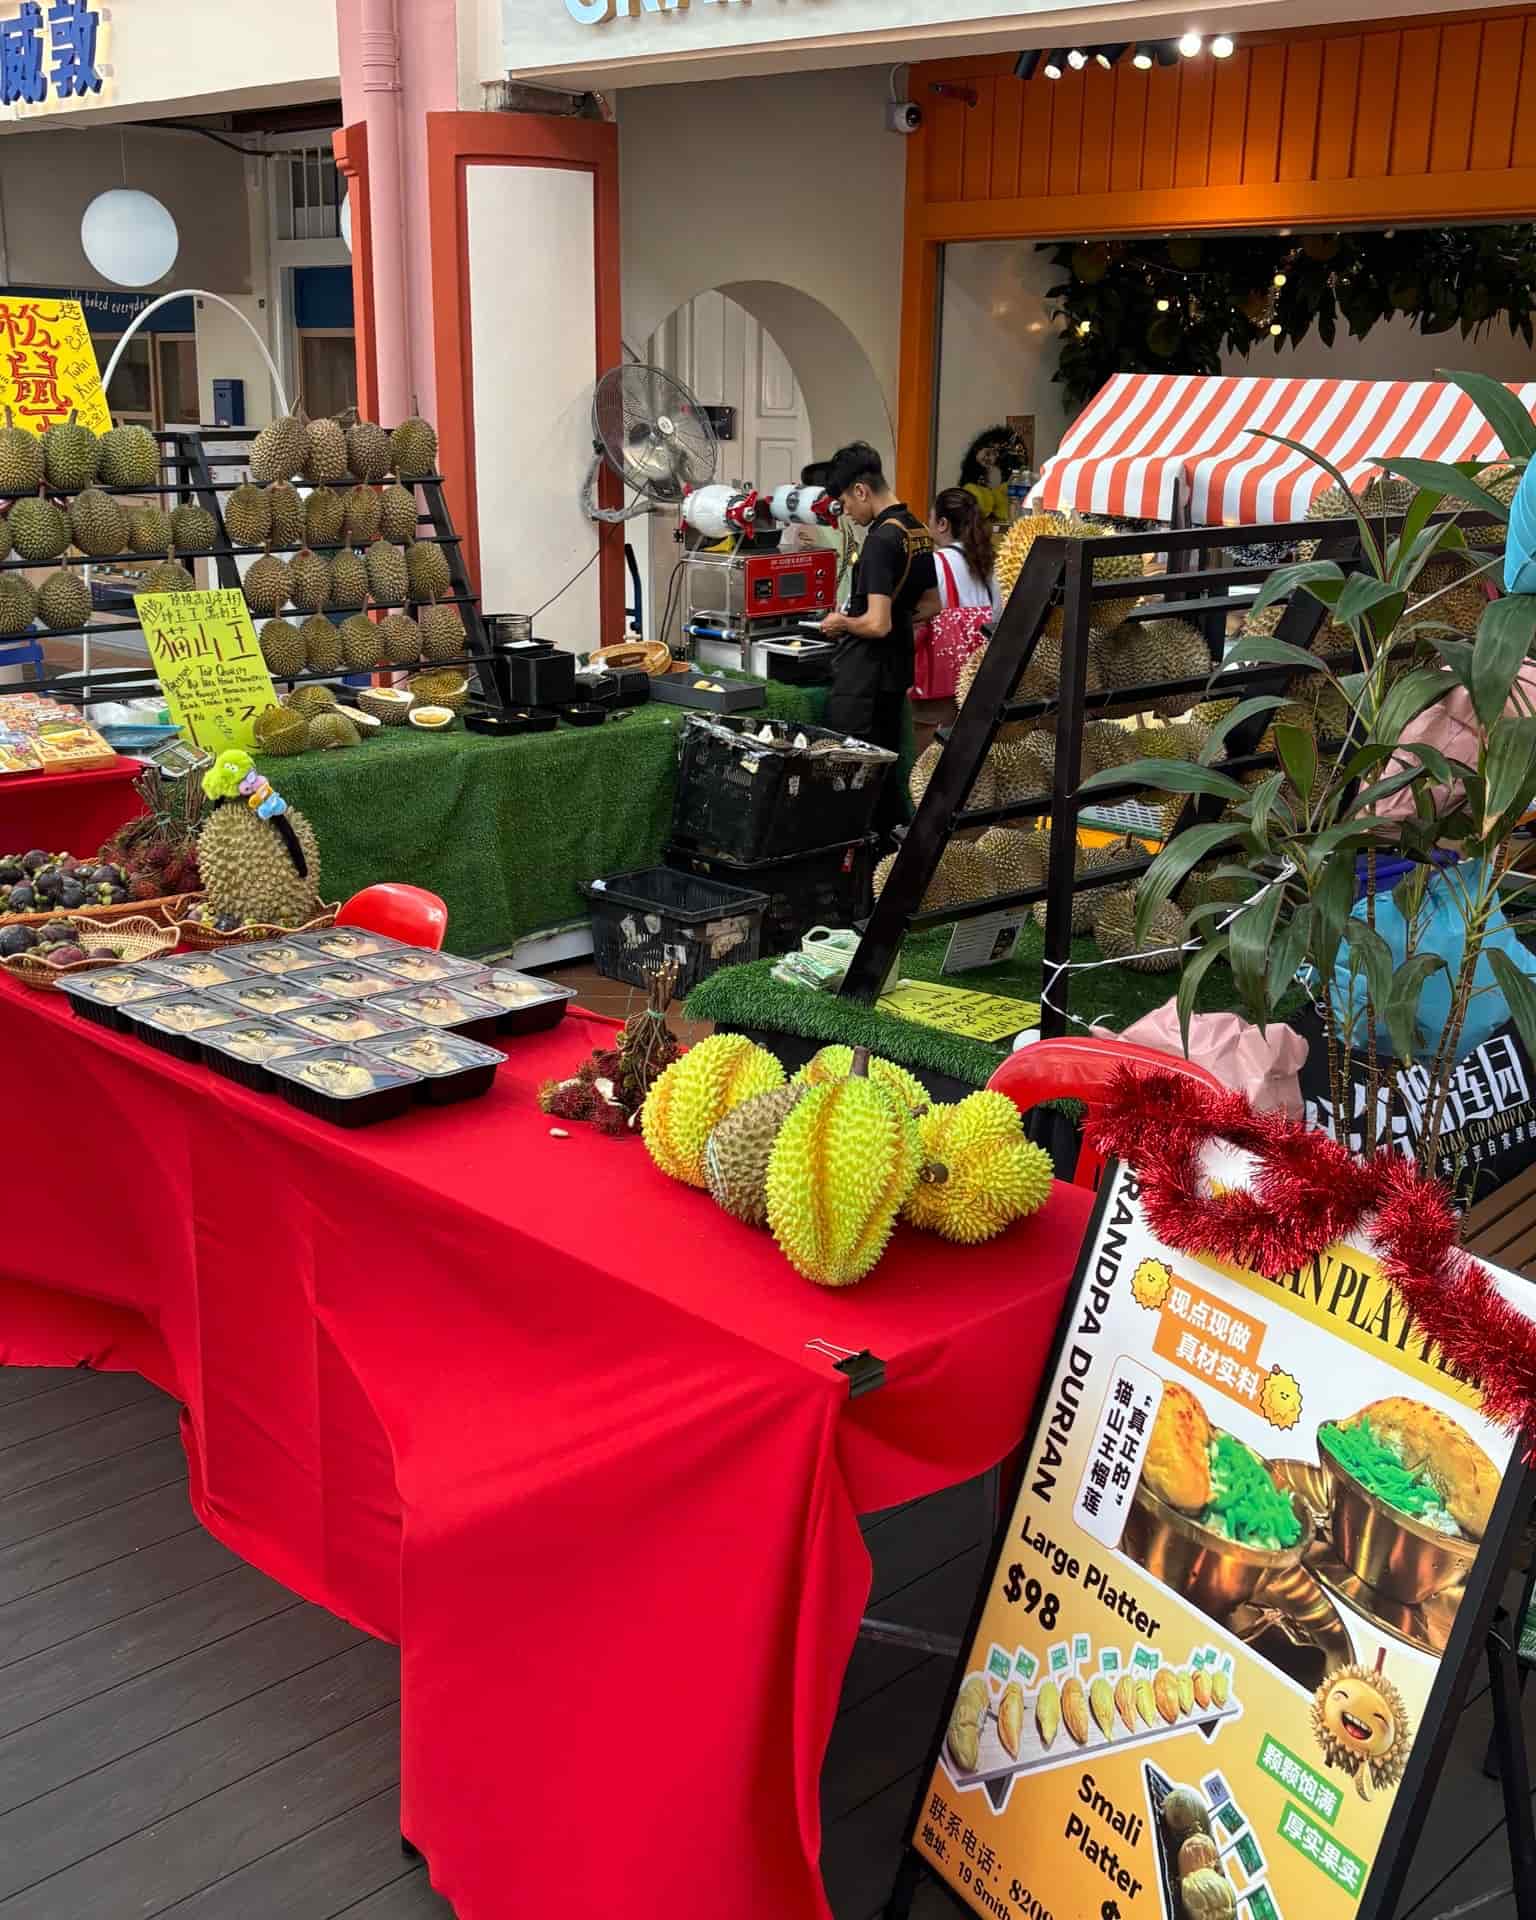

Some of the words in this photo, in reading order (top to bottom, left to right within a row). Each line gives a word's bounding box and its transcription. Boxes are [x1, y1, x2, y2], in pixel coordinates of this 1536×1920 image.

[1078, 1163, 1141, 1335] RANDPA
[1168, 1287, 1251, 1354] 现点现做
[1175, 1331, 1260, 1400] 真材实料
[1031, 1344, 1093, 1503] DURIAN
[1081, 1377, 1134, 1516] 猫山王榴莲
[1003, 1562, 1060, 1631] $98
[1020, 1515, 1080, 1579] Large
[1083, 1563, 1160, 1638] Platter
[1263, 1742, 1337, 1818] 颗颗饱满
[958, 1861, 973, 1884] 19
[1064, 1811, 1142, 1899] Platter
[1283, 1811, 1361, 1892] 厚实果实
